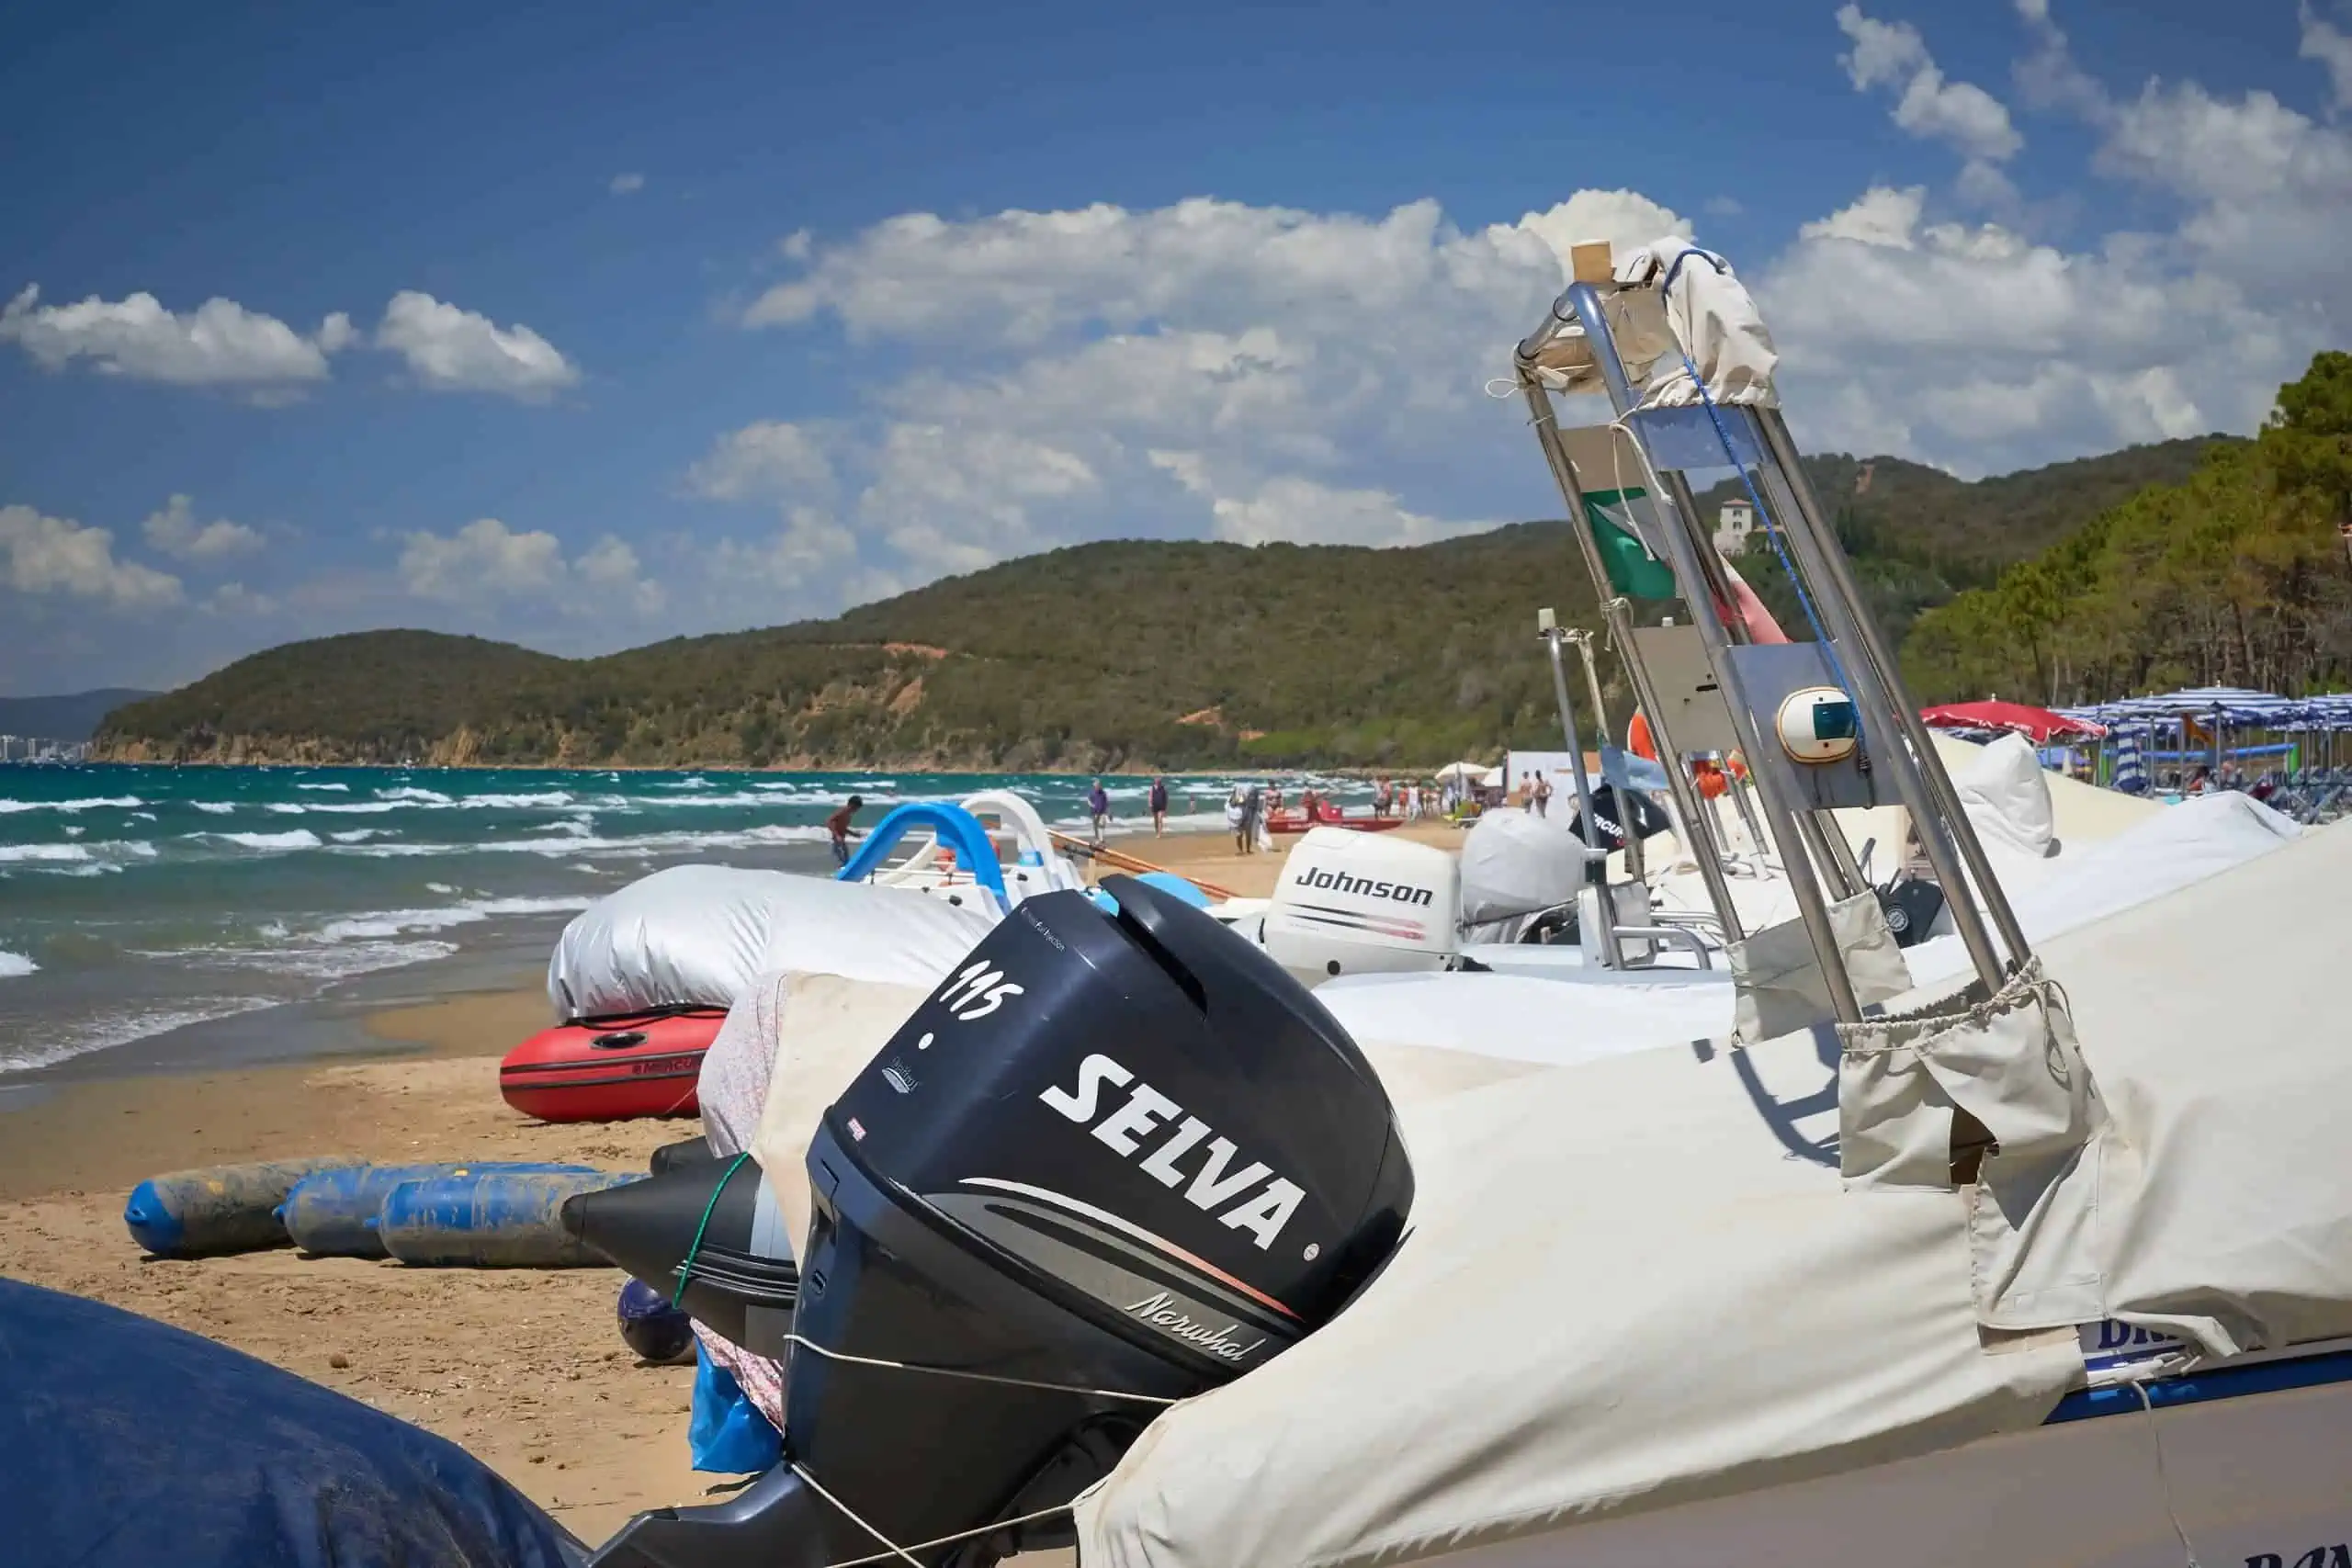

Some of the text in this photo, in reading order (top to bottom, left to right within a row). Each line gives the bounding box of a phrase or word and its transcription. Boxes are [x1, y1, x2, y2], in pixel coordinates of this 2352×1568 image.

[1295, 866, 1434, 906] Johnson
[939, 960, 1024, 1021] 115
[1038, 1054, 1306, 1251] SELVA
[1125, 1292, 1267, 1361] Narwhal
